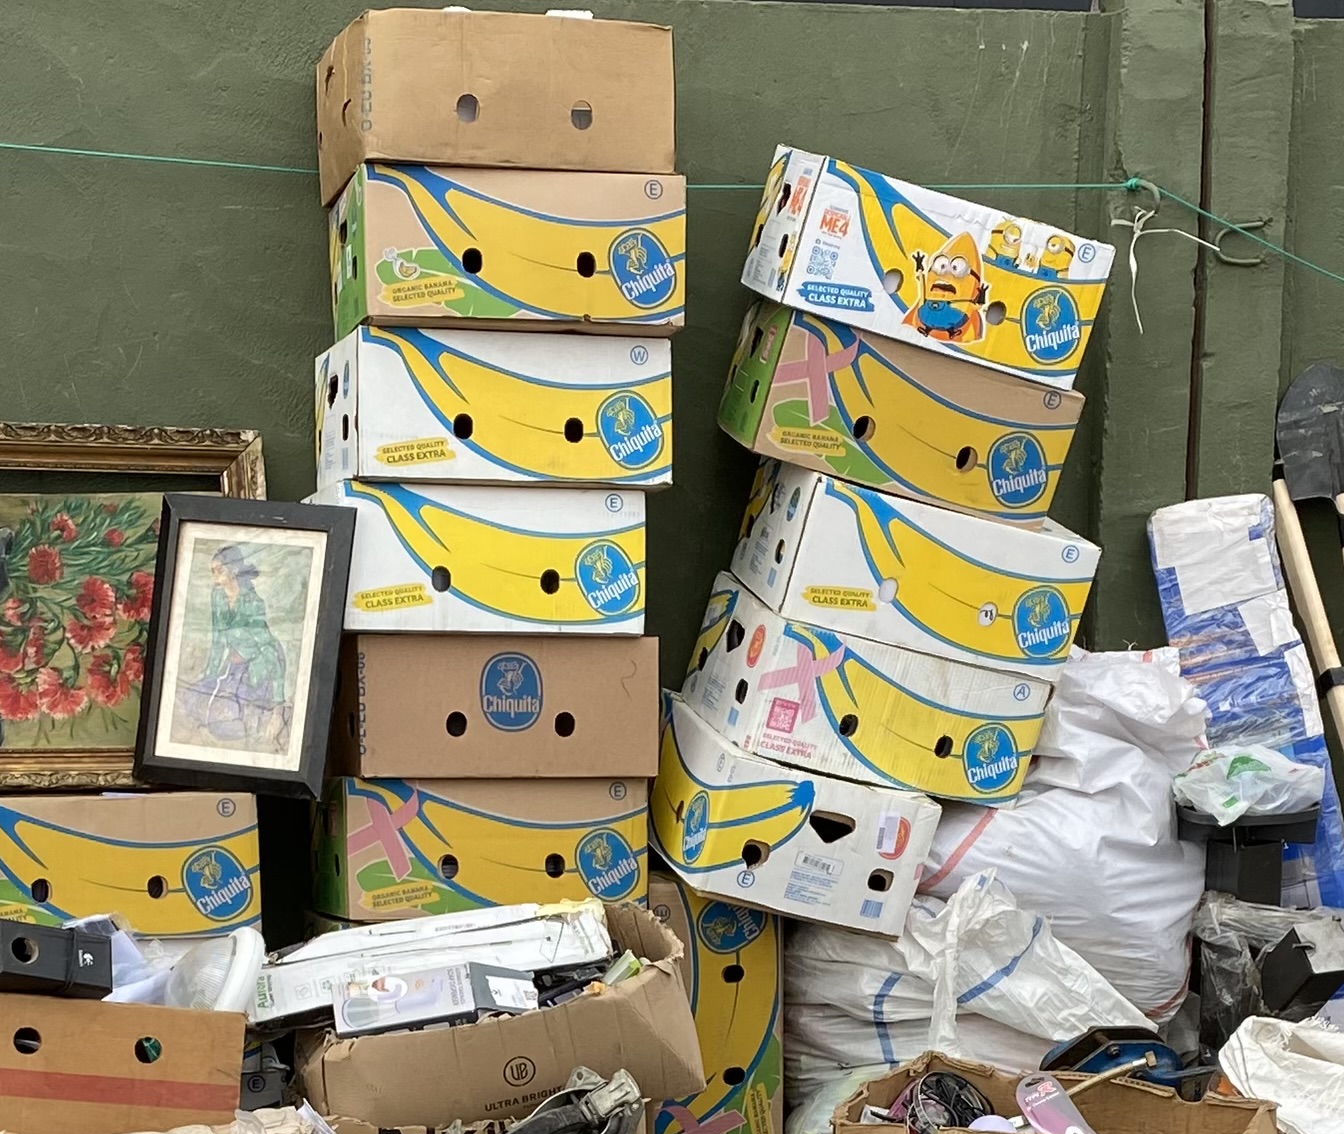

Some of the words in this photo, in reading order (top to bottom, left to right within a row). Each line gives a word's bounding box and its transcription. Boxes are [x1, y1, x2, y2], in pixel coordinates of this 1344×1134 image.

[621, 260, 675, 300] Chiquita
[426, 287, 456, 299] QUALITY
[807, 284, 839, 293] SELECTED
[840, 289, 869, 298] QUALITY
[808, 293, 836, 304] CLASS
[837, 297, 866, 308] EXTRA
[1025, 326, 1080, 354] Chiquita
[383, 444, 414, 454] SELECTED
[416, 441, 446, 451] QUALITY
[610, 423, 662, 462] Chiquita
[813, 441, 841, 450] QUALITY
[386, 454, 414, 464] CLASS
[417, 450, 446, 461] EXTRA
[992, 468, 1046, 498] Chiquita
[395, 586, 423, 595] QUALITY
[588, 569, 638, 608] Chiquita
[365, 599, 393, 609] CLASS
[394, 594, 424, 604] EXTRA
[812, 596, 838, 605] CLASS
[840, 598, 867, 607] EXTRA
[1017, 620, 1070, 649] Chiquita
[482, 694, 541, 718] Chiquita
[760, 741, 785, 753] CLASS
[786, 748, 812, 759] EXTRA
[968, 755, 1017, 783] Chiquita
[588, 856, 638, 894] Chiquita
[196, 874, 250, 917] Chiquita
[485, 1097, 519, 1112] ULTRA
